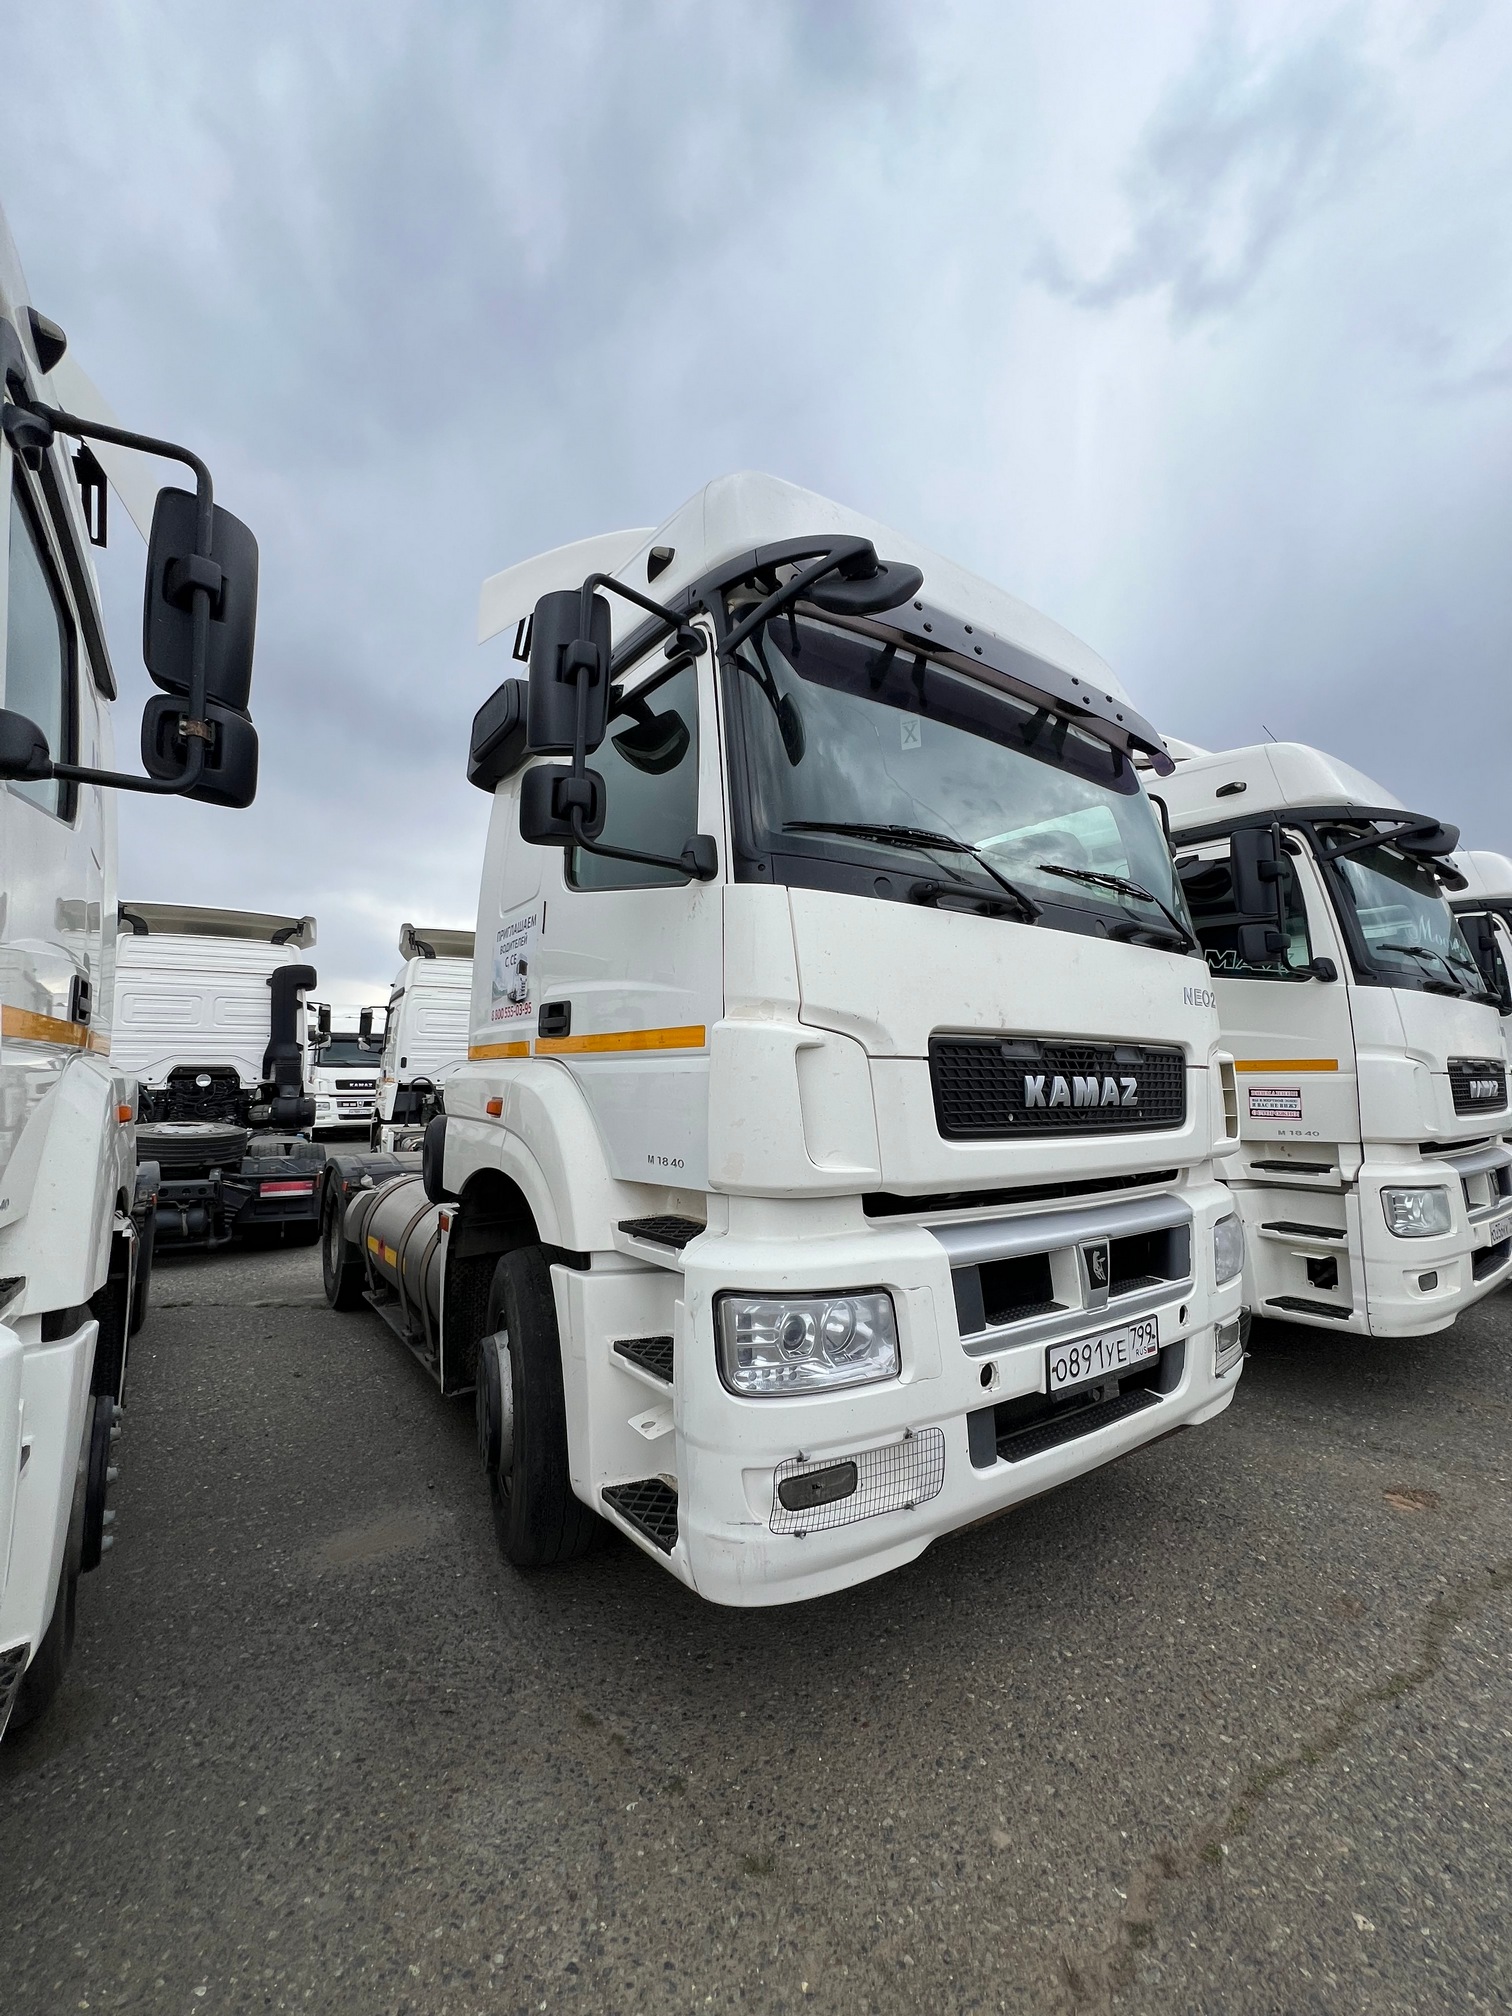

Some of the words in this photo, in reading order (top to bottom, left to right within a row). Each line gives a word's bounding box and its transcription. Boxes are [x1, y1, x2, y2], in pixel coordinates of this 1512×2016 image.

[496, 913, 537, 942] ПРИГЛАШАЕМ
[499, 932, 528, 955] ВОДИТЕЛЕЙ
[1183, 986, 1217, 1009] NEO2
[1024, 1075, 1139, 1108] KAMAZ
[647, 1154, 655, 1165] M
[1130, 1322, 1153, 1350] 799
[1135, 1346, 1148, 1357] RUS
